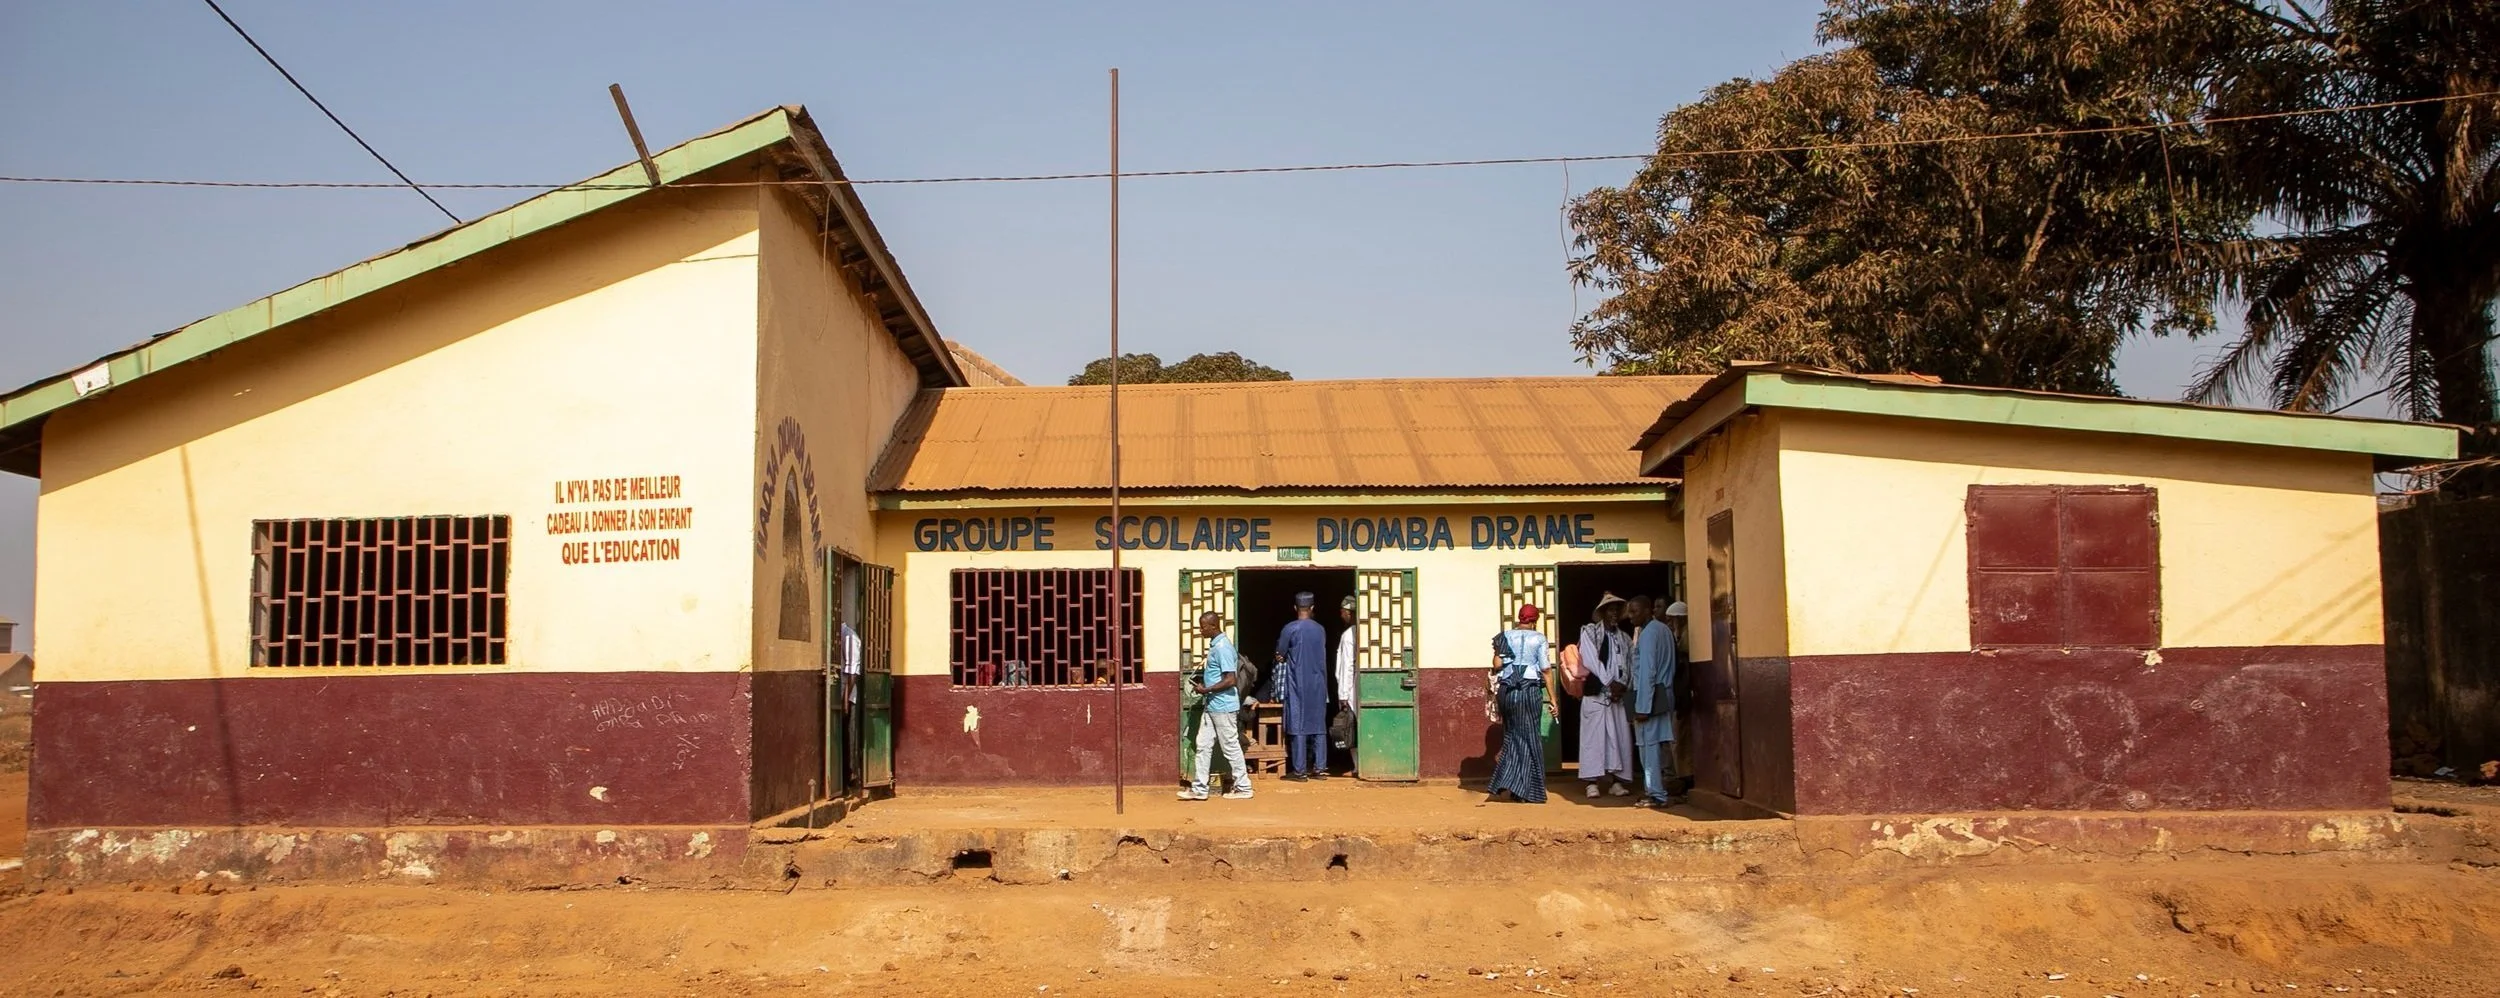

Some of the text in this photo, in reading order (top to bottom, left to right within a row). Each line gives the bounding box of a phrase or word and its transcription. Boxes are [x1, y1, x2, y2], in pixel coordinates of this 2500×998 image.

[555, 475, 681, 504] IL N'YA PAS DE MEILLEUR
[547, 507, 693, 535] CADEAU A DONNER A SON ENFANT
[913, 513, 1596, 552] GROUPE SCOLAIRE DIOMBA DRAME
[562, 538, 680, 565] QUE L'EDUCATION
